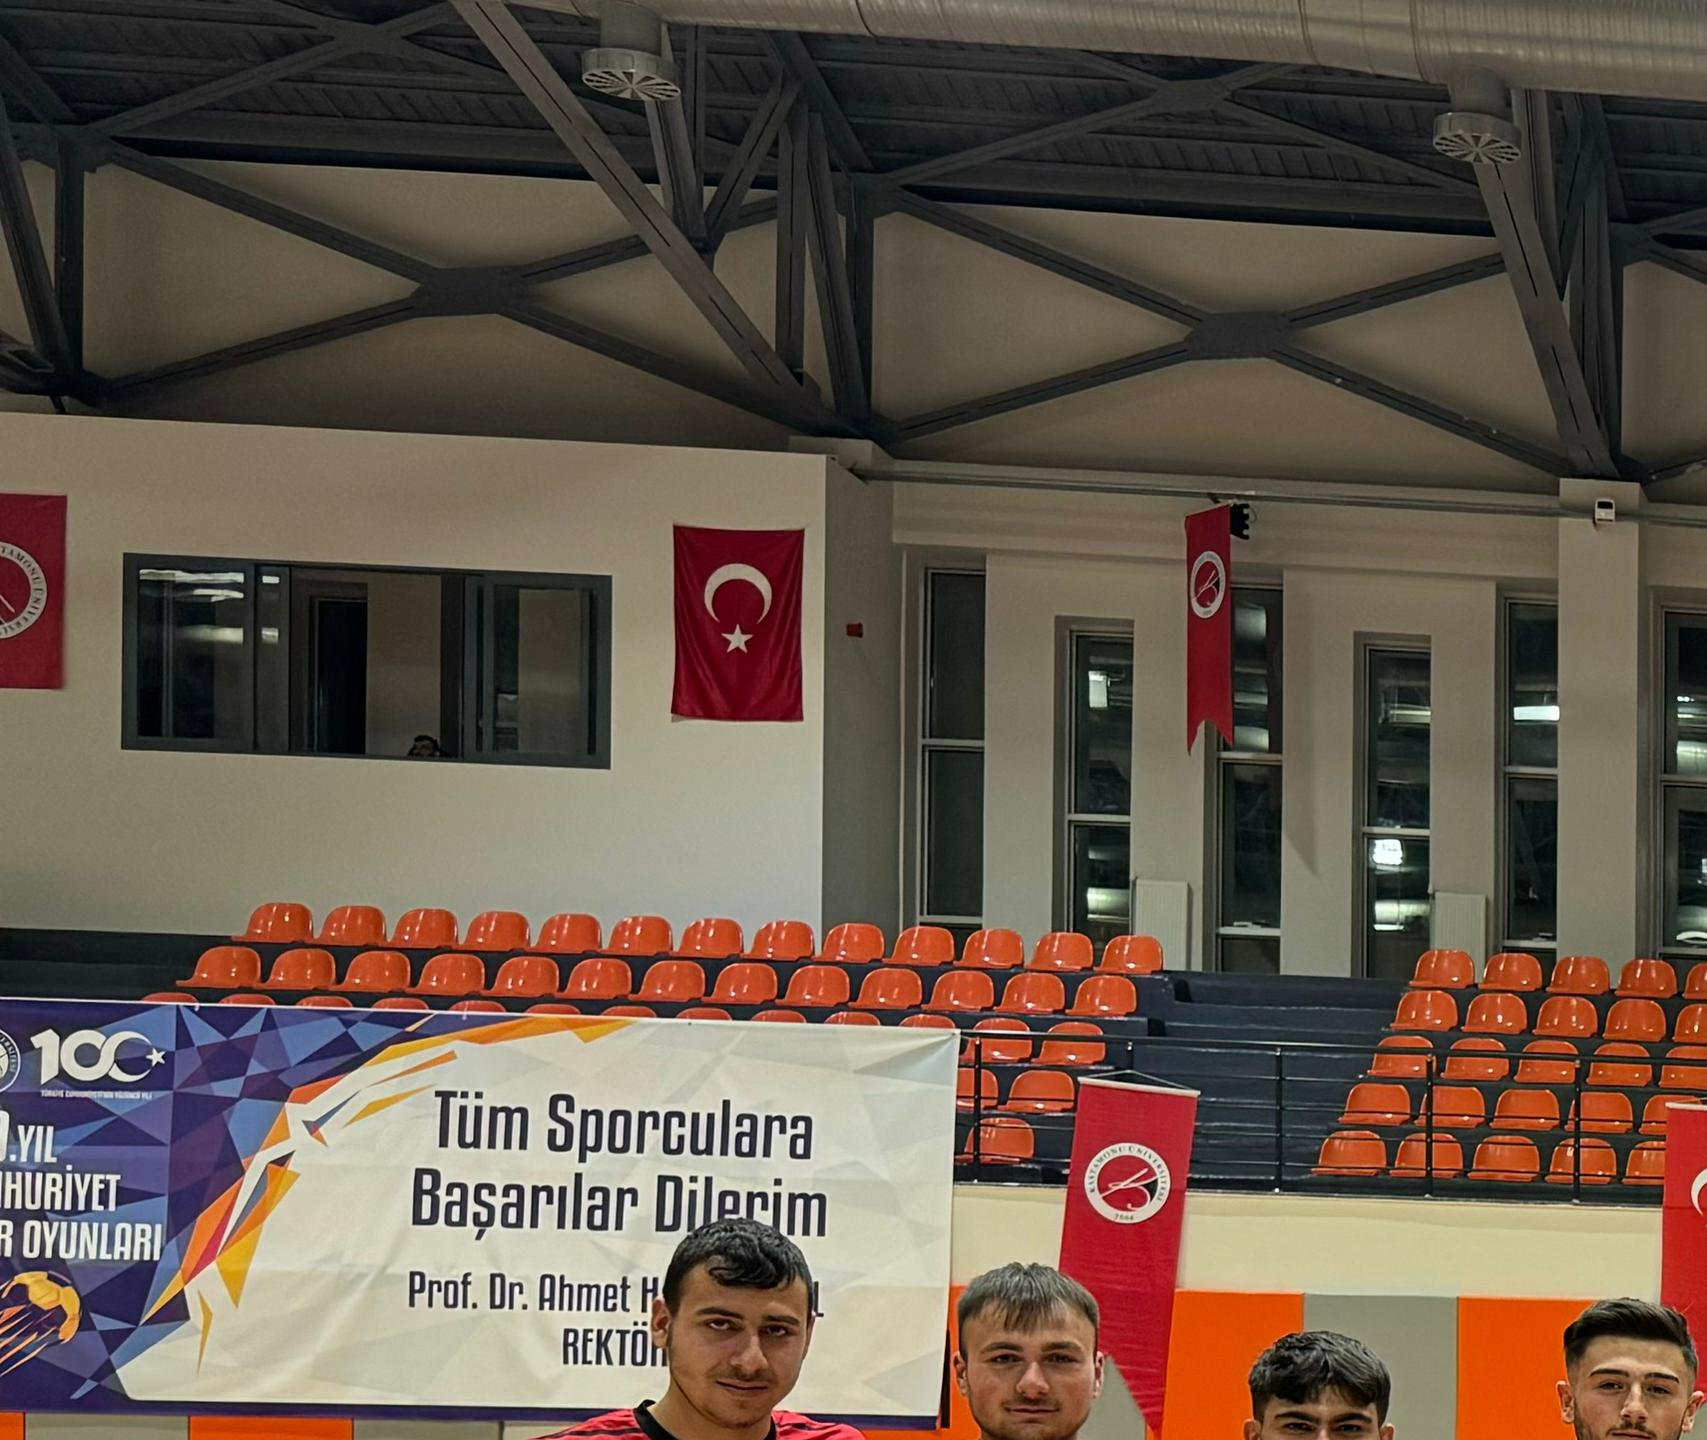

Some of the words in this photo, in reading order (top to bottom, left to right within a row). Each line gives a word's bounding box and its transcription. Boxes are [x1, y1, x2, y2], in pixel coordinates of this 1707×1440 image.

[434, 1091, 529, 1151] Tüm
[547, 1093, 813, 1163] Sporculara
[411, 1167, 639, 1241] Başarılar
[655, 1175, 828, 1237] Dilerim
[23, 1219, 162, 1261] OYUNLARI
[408, 1271, 478, 1309] Prof.
[489, 1272, 529, 1311] Dr.
[538, 1274, 631, 1313] Ahmet
